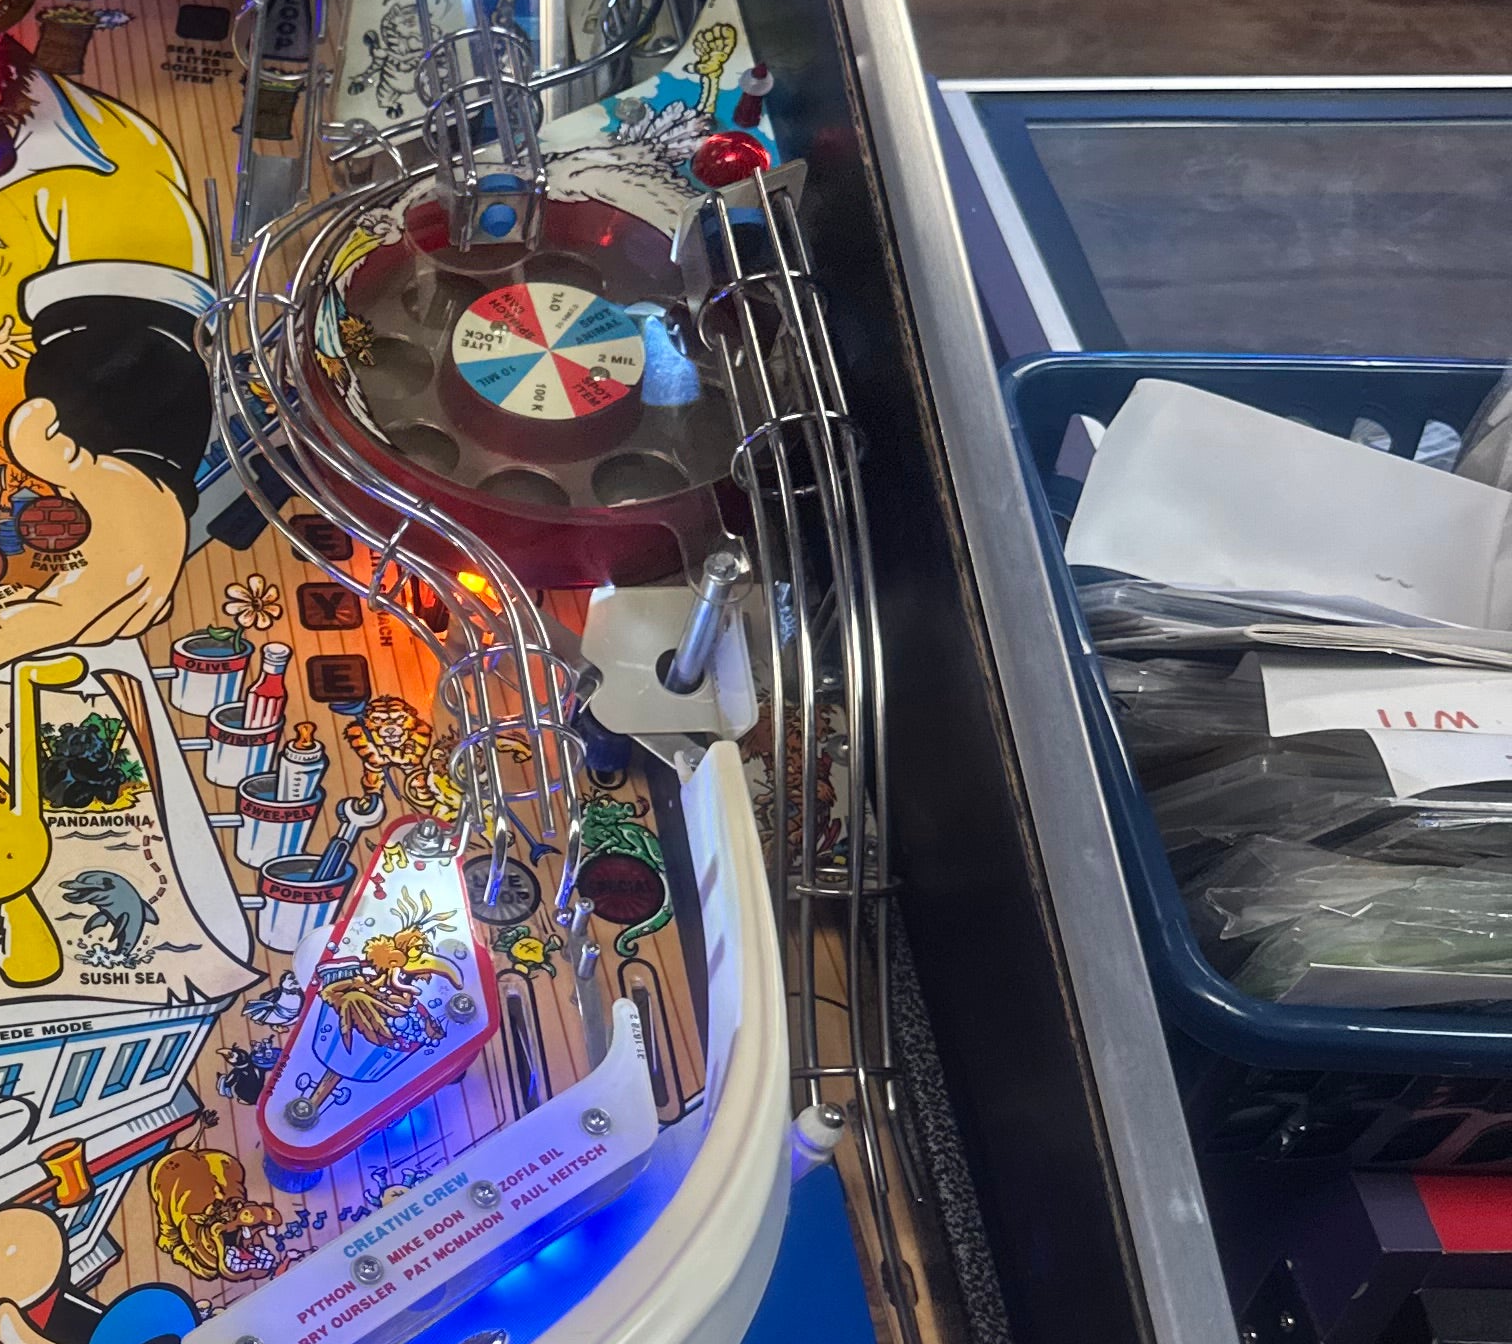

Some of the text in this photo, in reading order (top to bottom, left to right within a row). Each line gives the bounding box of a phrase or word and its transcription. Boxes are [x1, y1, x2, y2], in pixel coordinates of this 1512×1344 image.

[581, 308, 612, 328] SPOT
[575, 319, 623, 345] ANIMAL
[597, 354, 636, 366] 2 MIL
[30, 558, 88, 573] PAVERS
[32, 551, 83, 563] EARTH
[185, 659, 231, 672] OLIVE
[216, 732, 268, 746] WIMPY
[242, 802, 312, 821] SWEE-PEA
[47, 815, 151, 829] PANDAMONIA
[269, 884, 336, 903] POPEYE
[80, 972, 166, 985] SUSHI SEA
[41, 1020, 95, 1037] MODE
[342, 1171, 471, 1259] CREATIVE CREW
[296, 1146, 564, 1325] PYTHON MIKE BOON ZOFIA BIL
[330, 1281, 397, 1329] OURSLER
[402, 1259, 432, 1281] PAT
[432, 1210, 505, 1261] MCMAHON
[511, 1182, 549, 1211] PAUL
[547, 1143, 609, 1186] HEITSCH
